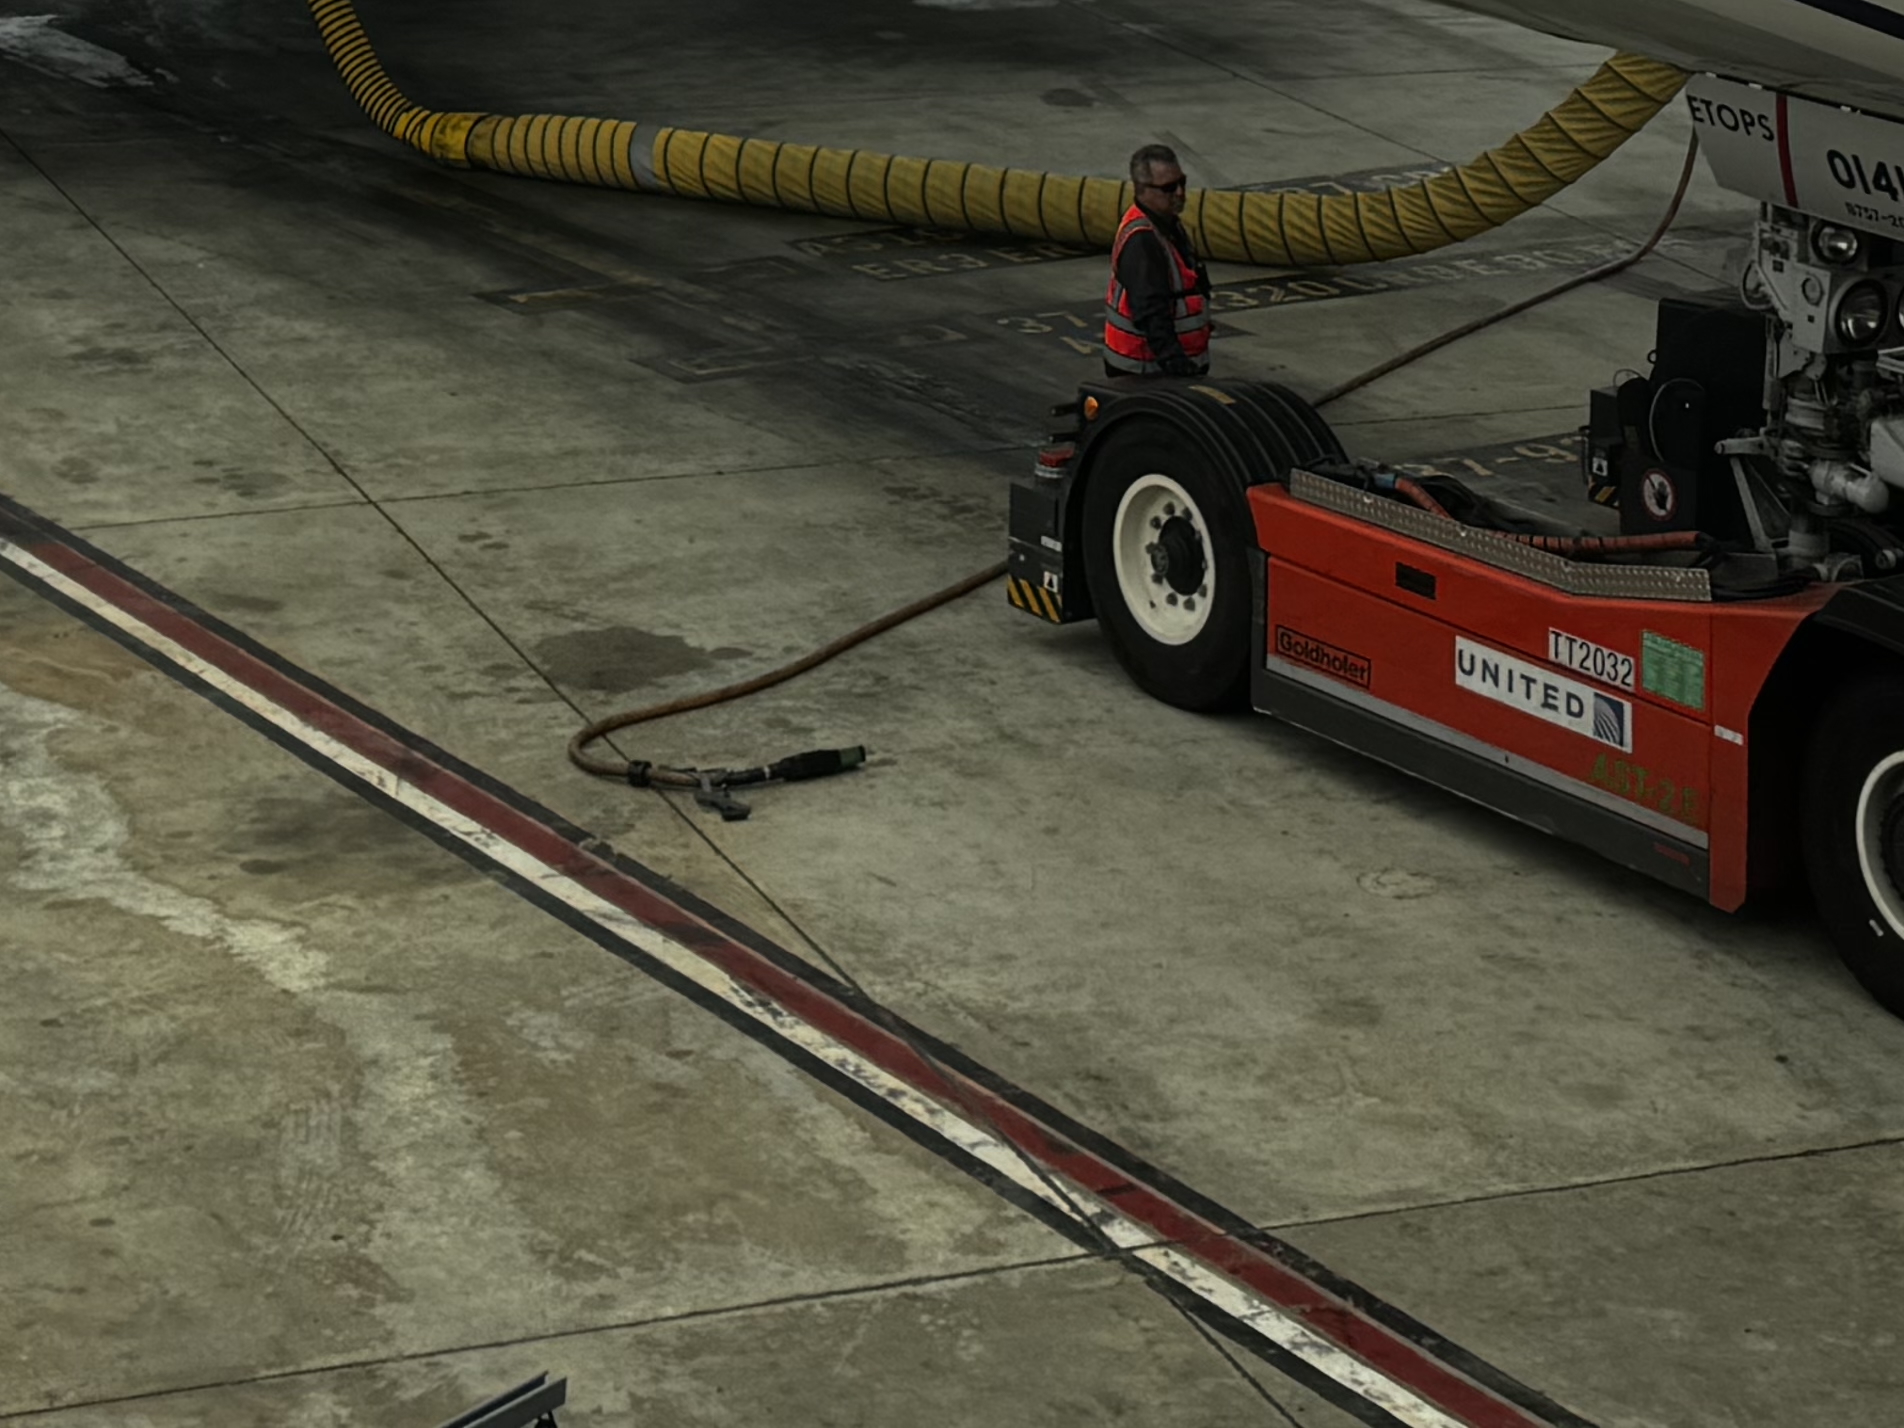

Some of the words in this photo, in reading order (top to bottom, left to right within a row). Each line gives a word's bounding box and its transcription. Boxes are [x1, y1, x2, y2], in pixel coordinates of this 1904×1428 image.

[1687, 95, 1776, 142] ETOPS
[1457, 649, 1585, 720] UNITED
[1552, 630, 1634, 688] TT2032
